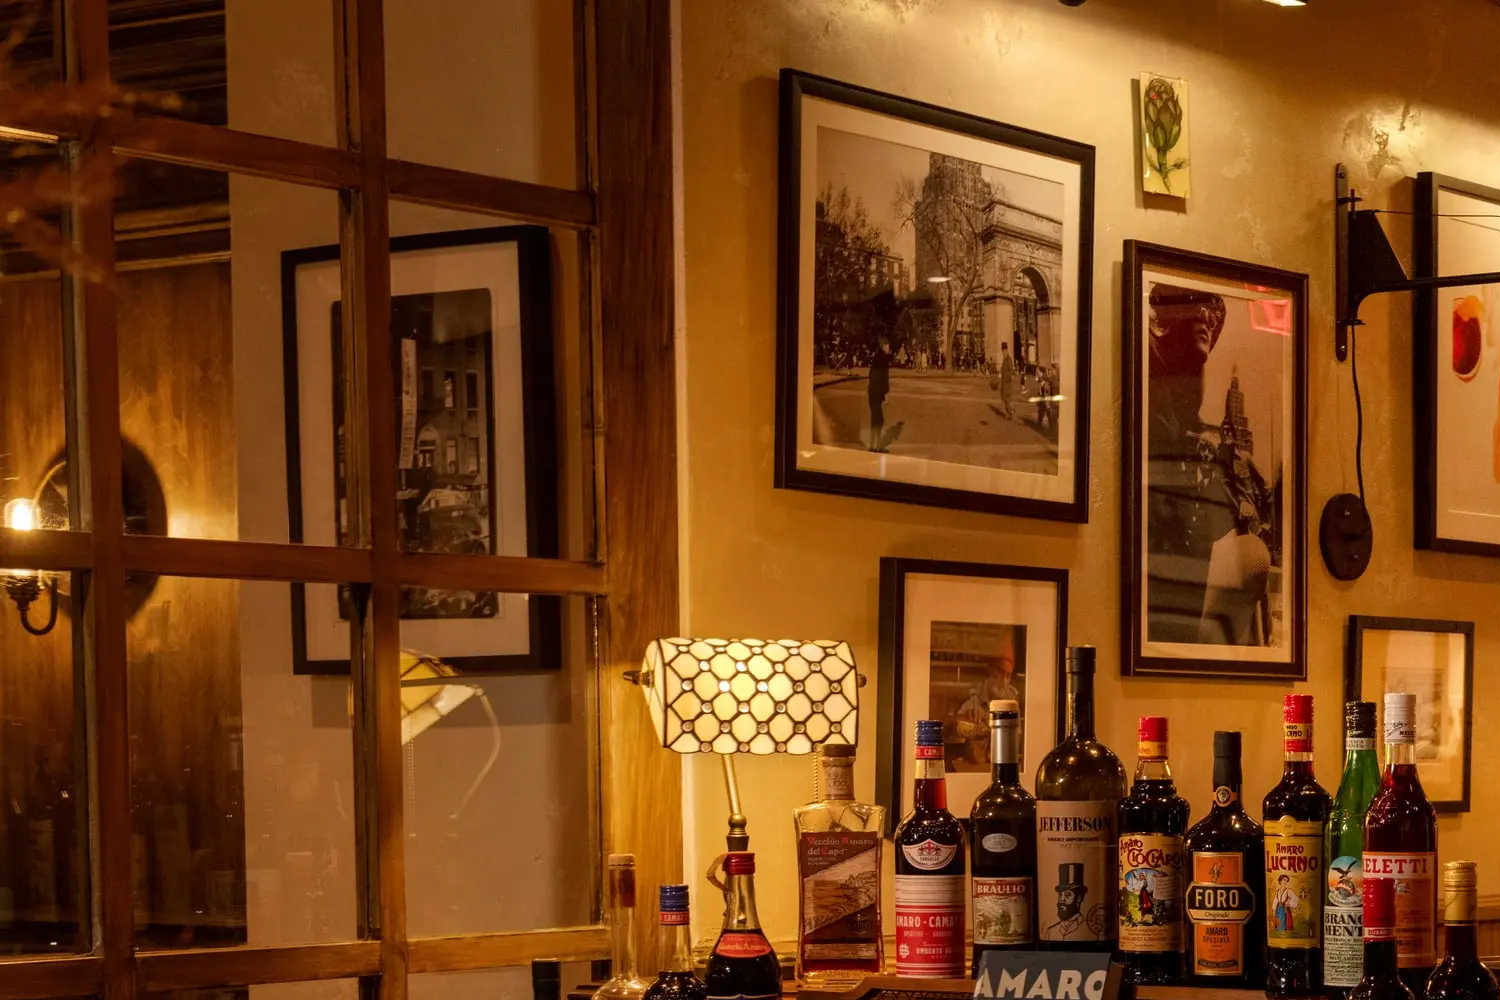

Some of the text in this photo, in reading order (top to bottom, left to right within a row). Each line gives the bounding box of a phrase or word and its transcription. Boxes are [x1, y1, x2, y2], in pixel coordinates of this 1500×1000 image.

[1039, 816, 1110, 833] JEFFERSON
[1276, 843, 1304, 855] AMARO
[1266, 850, 1318, 873] LUCANO
[1363, 858, 1427, 873] ELETTI
[976, 884, 1026, 894] BRAULIO
[1195, 889, 1239, 908] FORO
[896, 915, 921, 928] MARO
[1205, 927, 1229, 936] AMARO
